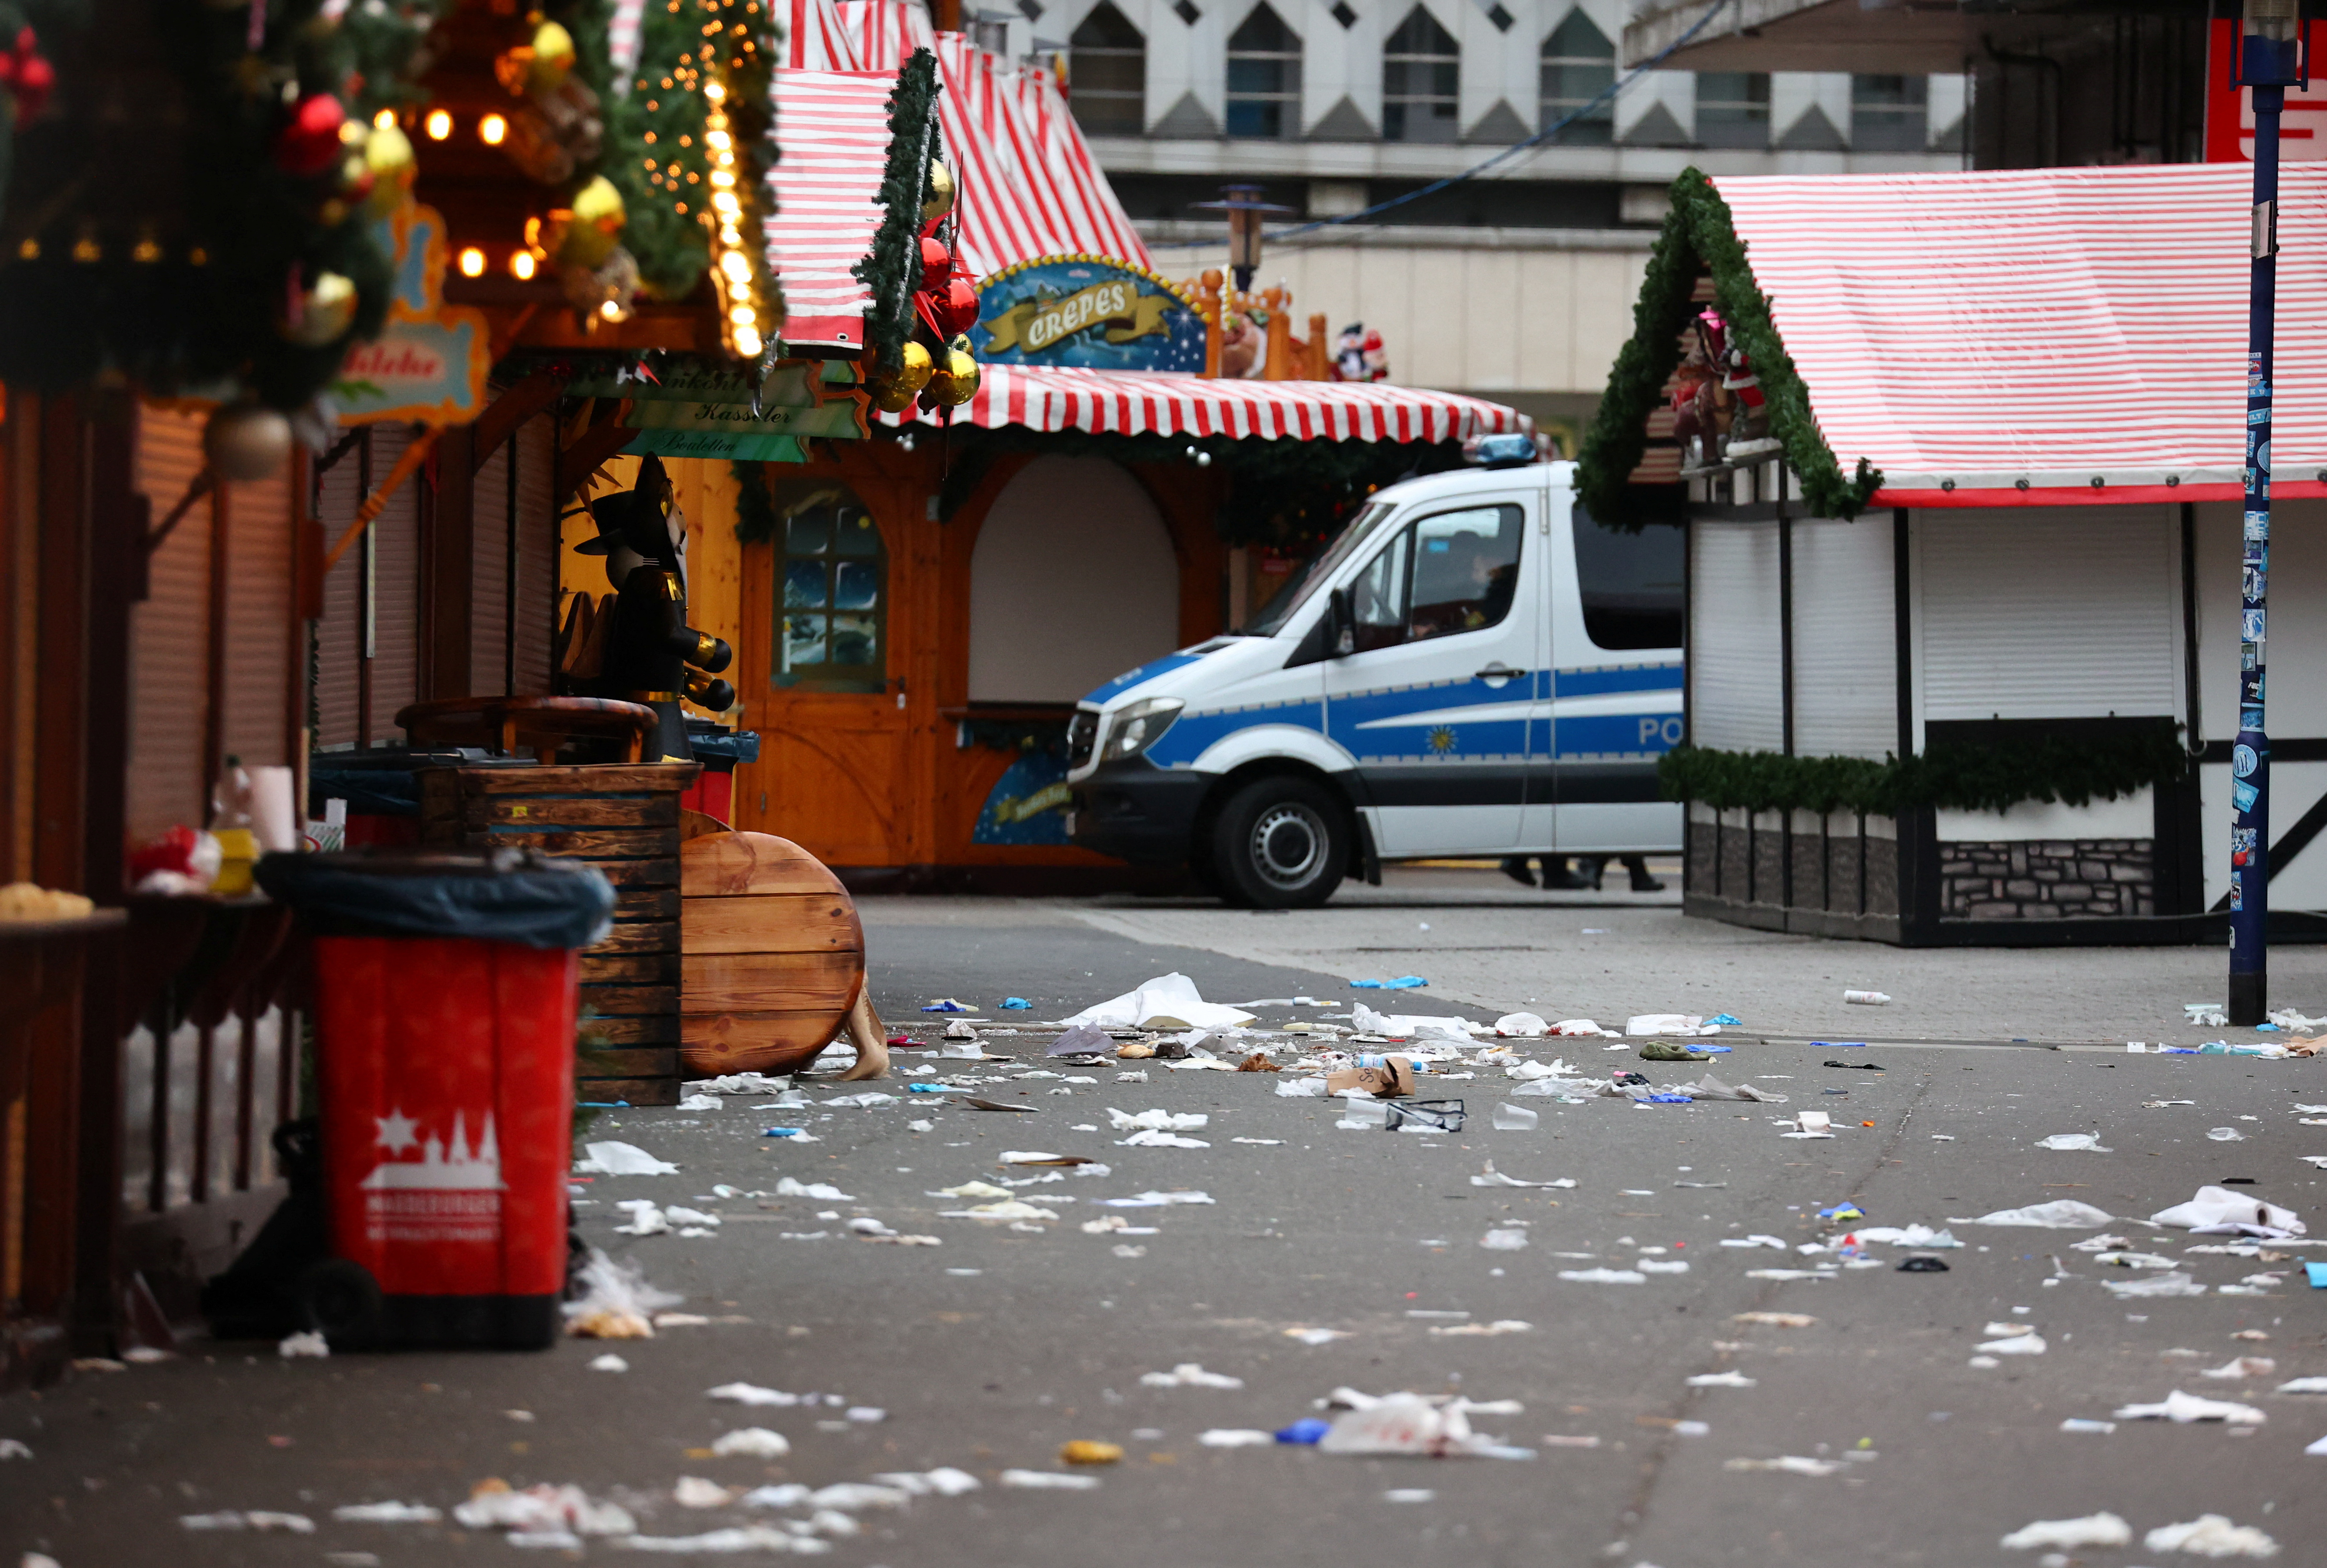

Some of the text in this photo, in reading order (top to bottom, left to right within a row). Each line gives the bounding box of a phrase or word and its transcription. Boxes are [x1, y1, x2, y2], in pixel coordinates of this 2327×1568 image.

[1028, 285, 1125, 345] CREPES
[695, 403, 792, 423] Kasseler
[653, 431, 735, 452] Bouletten
[1639, 717, 1684, 745] PO
